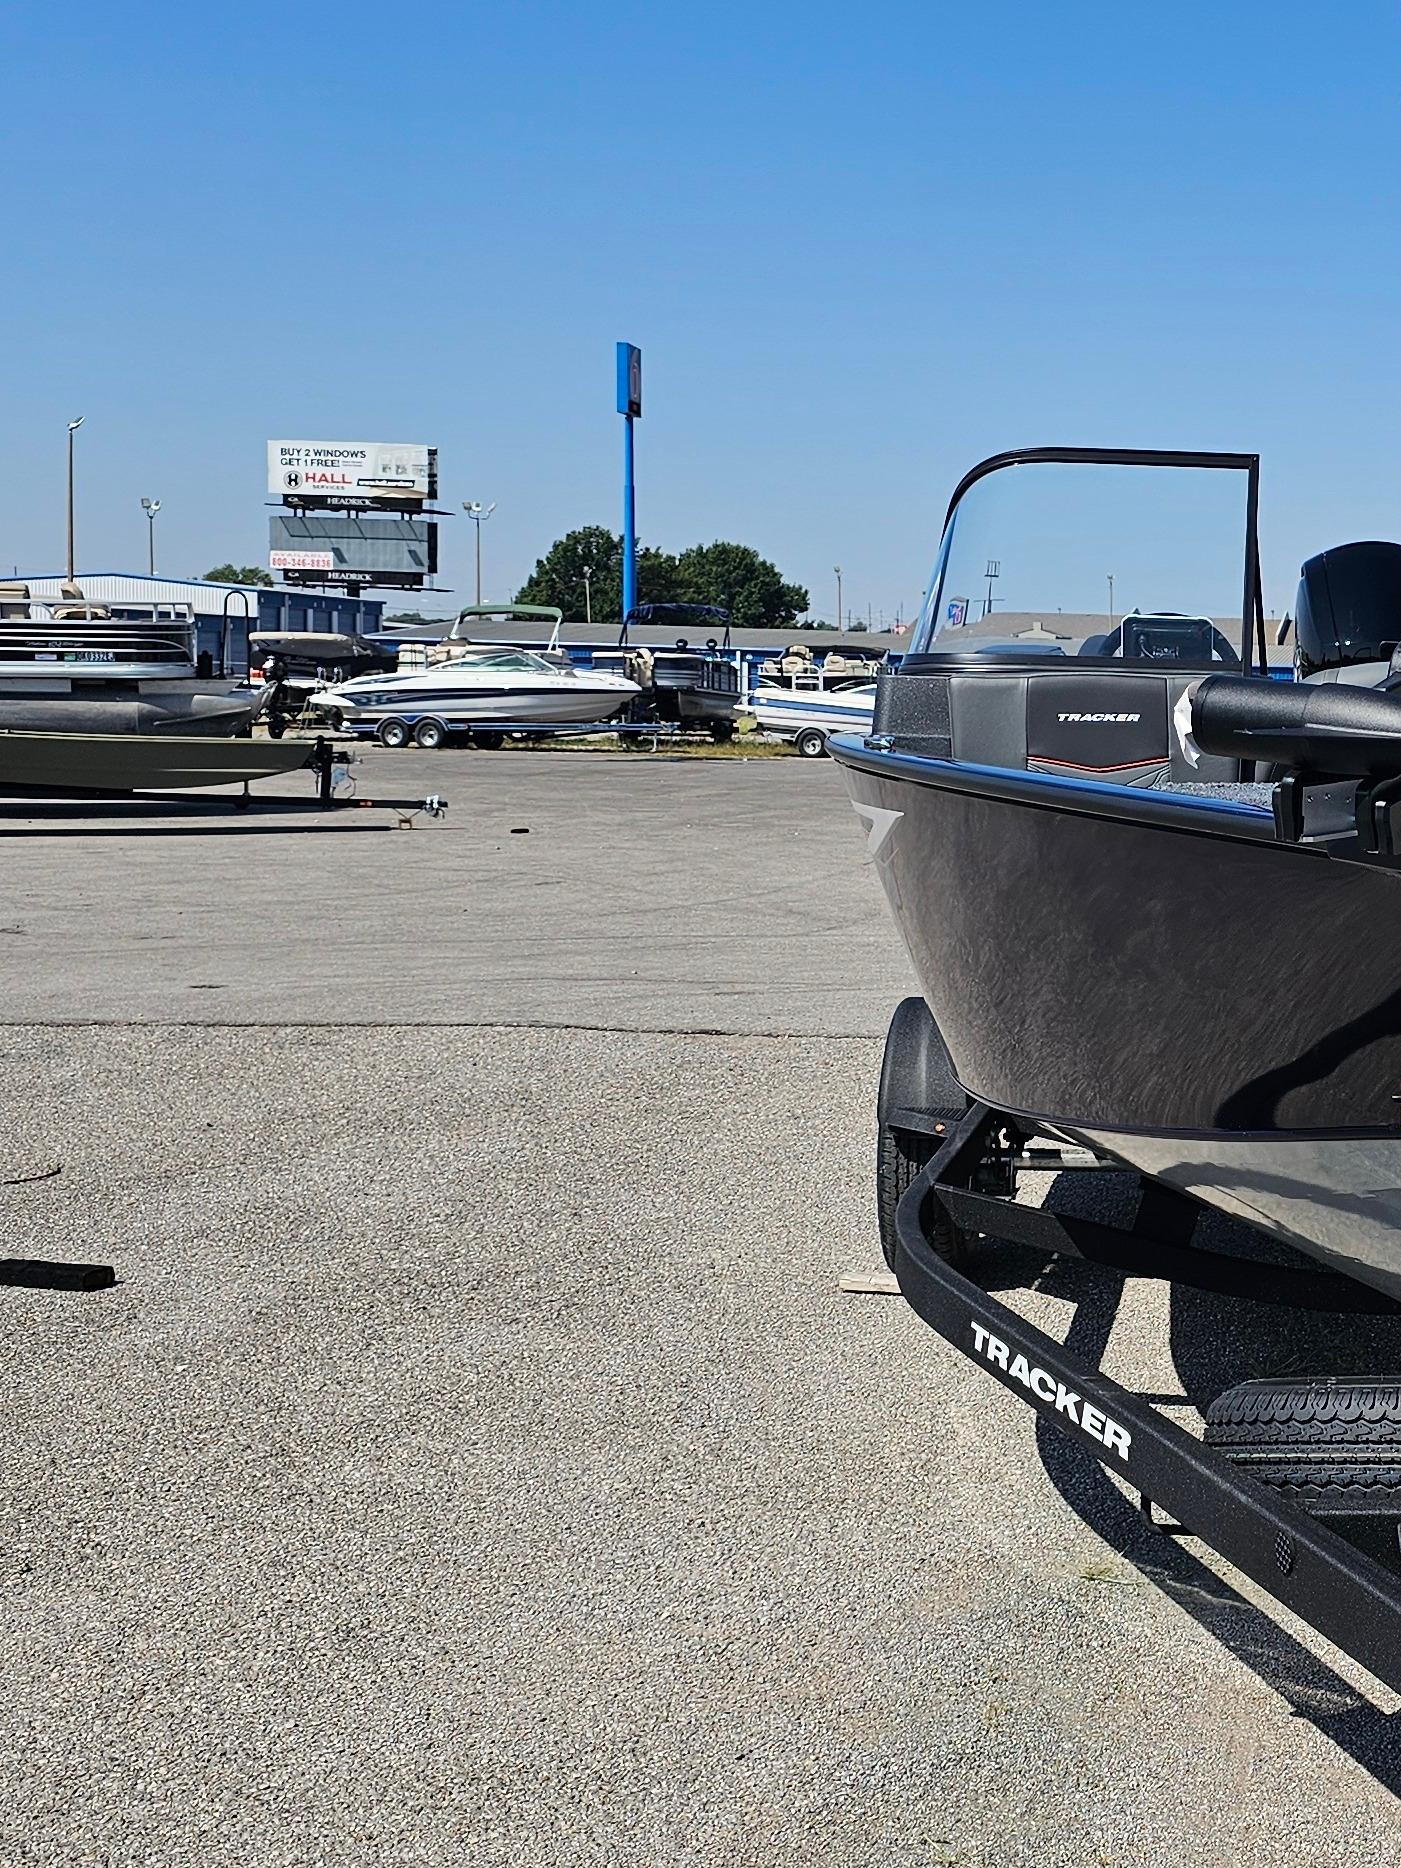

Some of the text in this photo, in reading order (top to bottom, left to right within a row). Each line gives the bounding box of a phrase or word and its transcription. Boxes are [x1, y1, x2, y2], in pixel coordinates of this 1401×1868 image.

[280, 447, 367, 459] BUY 2 WINDOWS
[280, 458, 301, 466] GET
[310, 459, 340, 467] FREE!
[305, 472, 352, 484] HALL
[327, 497, 373, 506] HEADRICK
[327, 572, 373, 581] HEADRICK
[1057, 713, 1141, 722] TRACKER
[970, 1320, 1132, 1462] TRACKER
